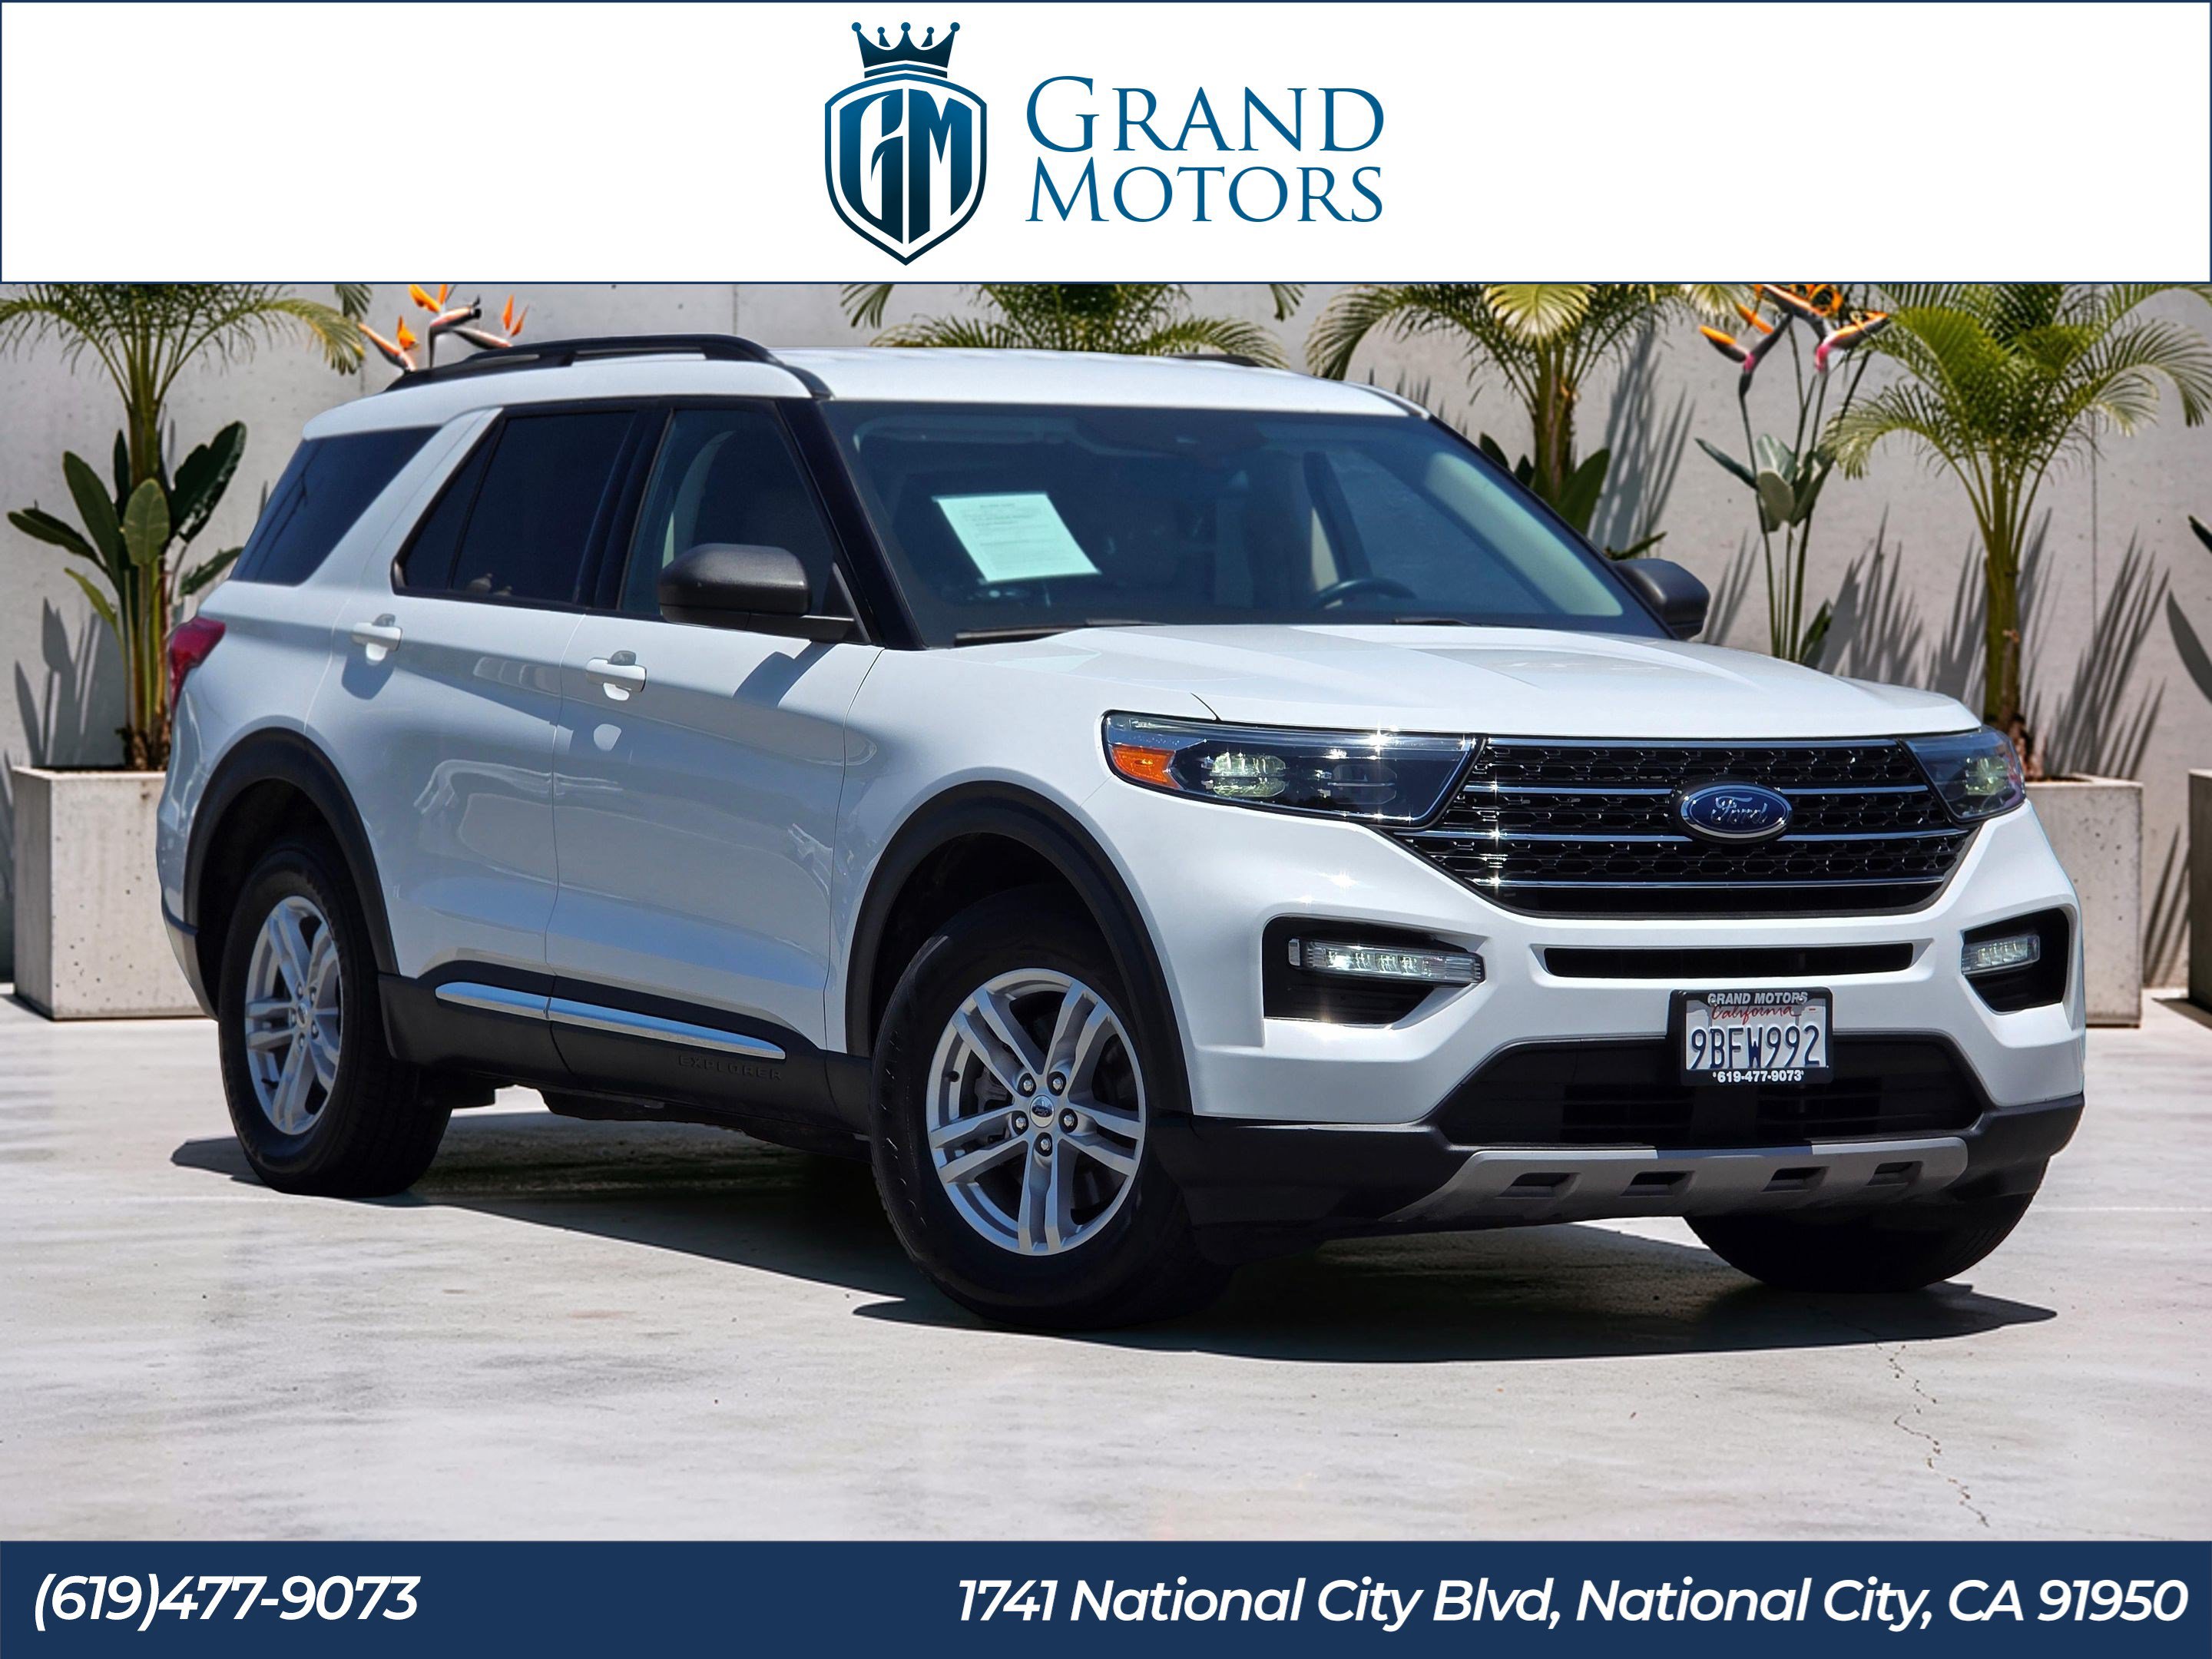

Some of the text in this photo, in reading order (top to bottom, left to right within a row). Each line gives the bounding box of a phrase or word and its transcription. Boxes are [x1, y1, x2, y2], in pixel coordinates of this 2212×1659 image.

[1710, 796, 1768, 824] Ford
[1707, 992, 1808, 1005] GRAND MOTORS
[1711, 1005, 1802, 1025] California
[1691, 1025, 1820, 1069] 9BFW992
[678, 1055, 782, 1081] EXPLORER
